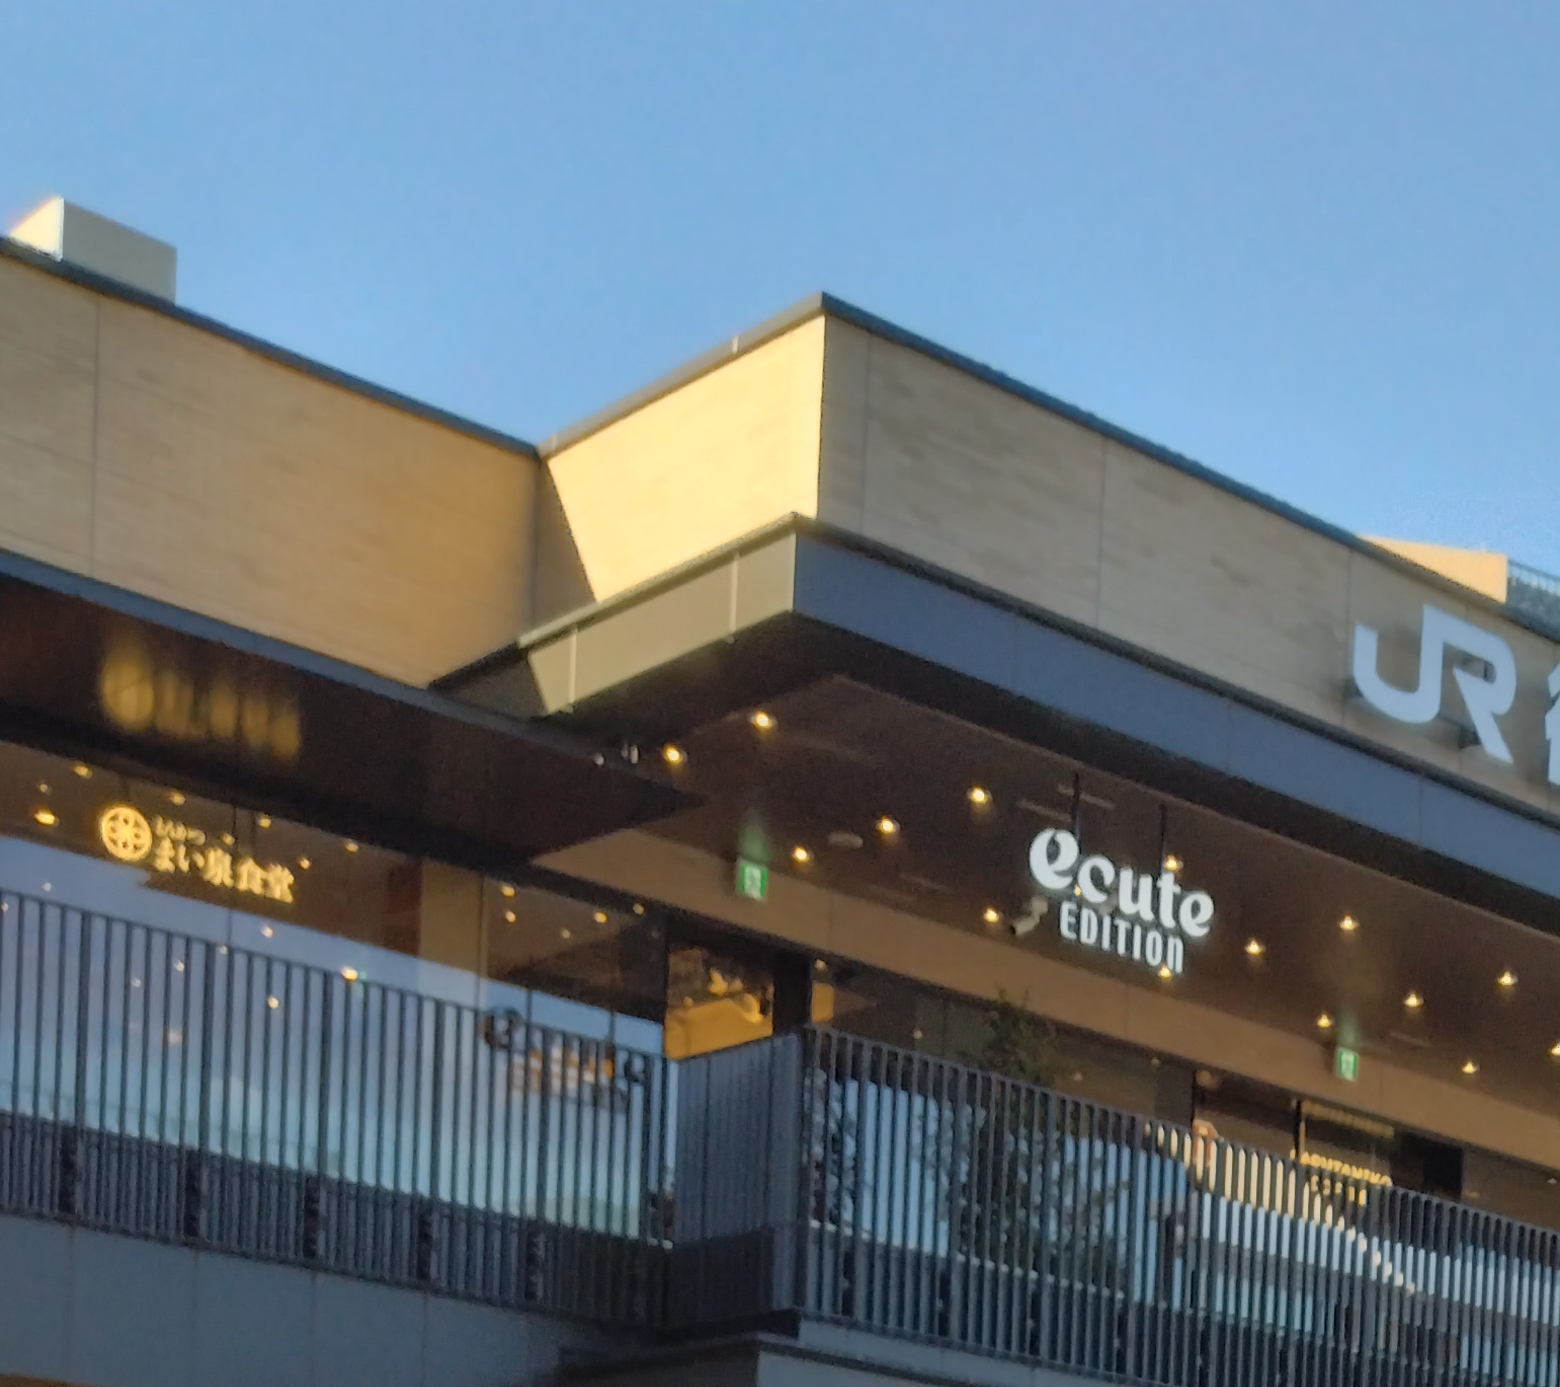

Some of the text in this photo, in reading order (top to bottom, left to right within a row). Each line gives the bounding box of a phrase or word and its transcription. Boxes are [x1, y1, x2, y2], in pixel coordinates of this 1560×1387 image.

[1353, 604, 1514, 765] JR
[1029, 828, 1215, 938] ecute
[1060, 900, 1184, 974] EDITION
